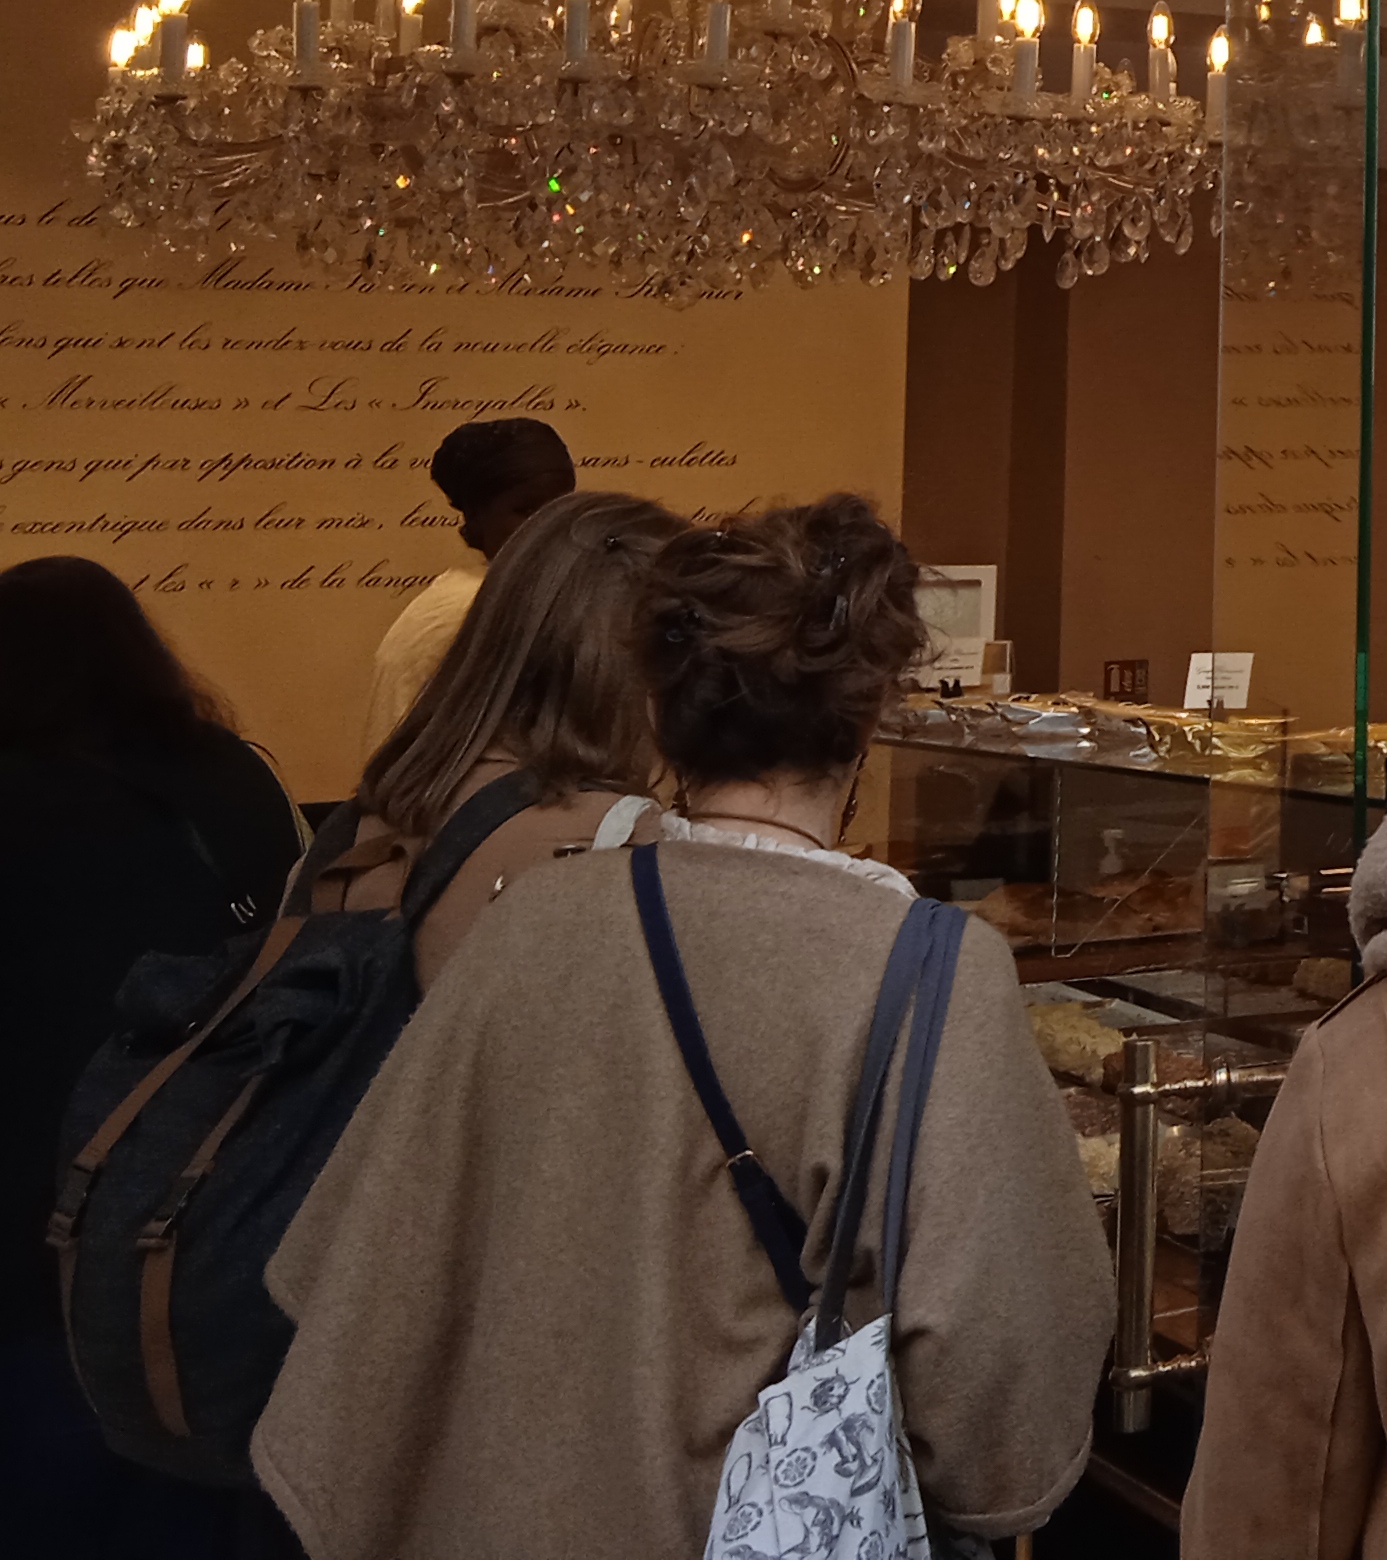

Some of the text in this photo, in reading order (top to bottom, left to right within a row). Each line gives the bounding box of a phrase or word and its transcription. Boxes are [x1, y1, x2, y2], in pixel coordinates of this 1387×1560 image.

[113, 278, 169, 300] que
[177, 256, 317, 291] Madame
[47, 331, 109, 360] qui
[109, 331, 176, 350] sont
[179, 321, 213, 351] les
[379, 327, 413, 352] de
[418, 327, 448, 353] la
[453, 326, 570, 354] nouvelle
[22, 374, 222, 412] Merveilleuses
[260, 392, 293, 411] et
[298, 374, 358, 412] Les
[391, 376, 555, 421] Incroyables
[0, 458, 77, 485] gens
[79, 453, 138, 483] qui
[125, 452, 191, 483] par
[197, 449, 337, 483] opposition
[344, 452, 363, 471] à
[372, 441, 405, 471] la
[11, 512, 170, 545] excentrique
[177, 506, 246, 532] dans
[253, 501, 306, 532] leur
[400, 500, 460, 528] leurs
[154, 562, 189, 593] les
[280, 565, 316, 591] de
[319, 559, 354, 590] la
[356, 558, 438, 598] langu
